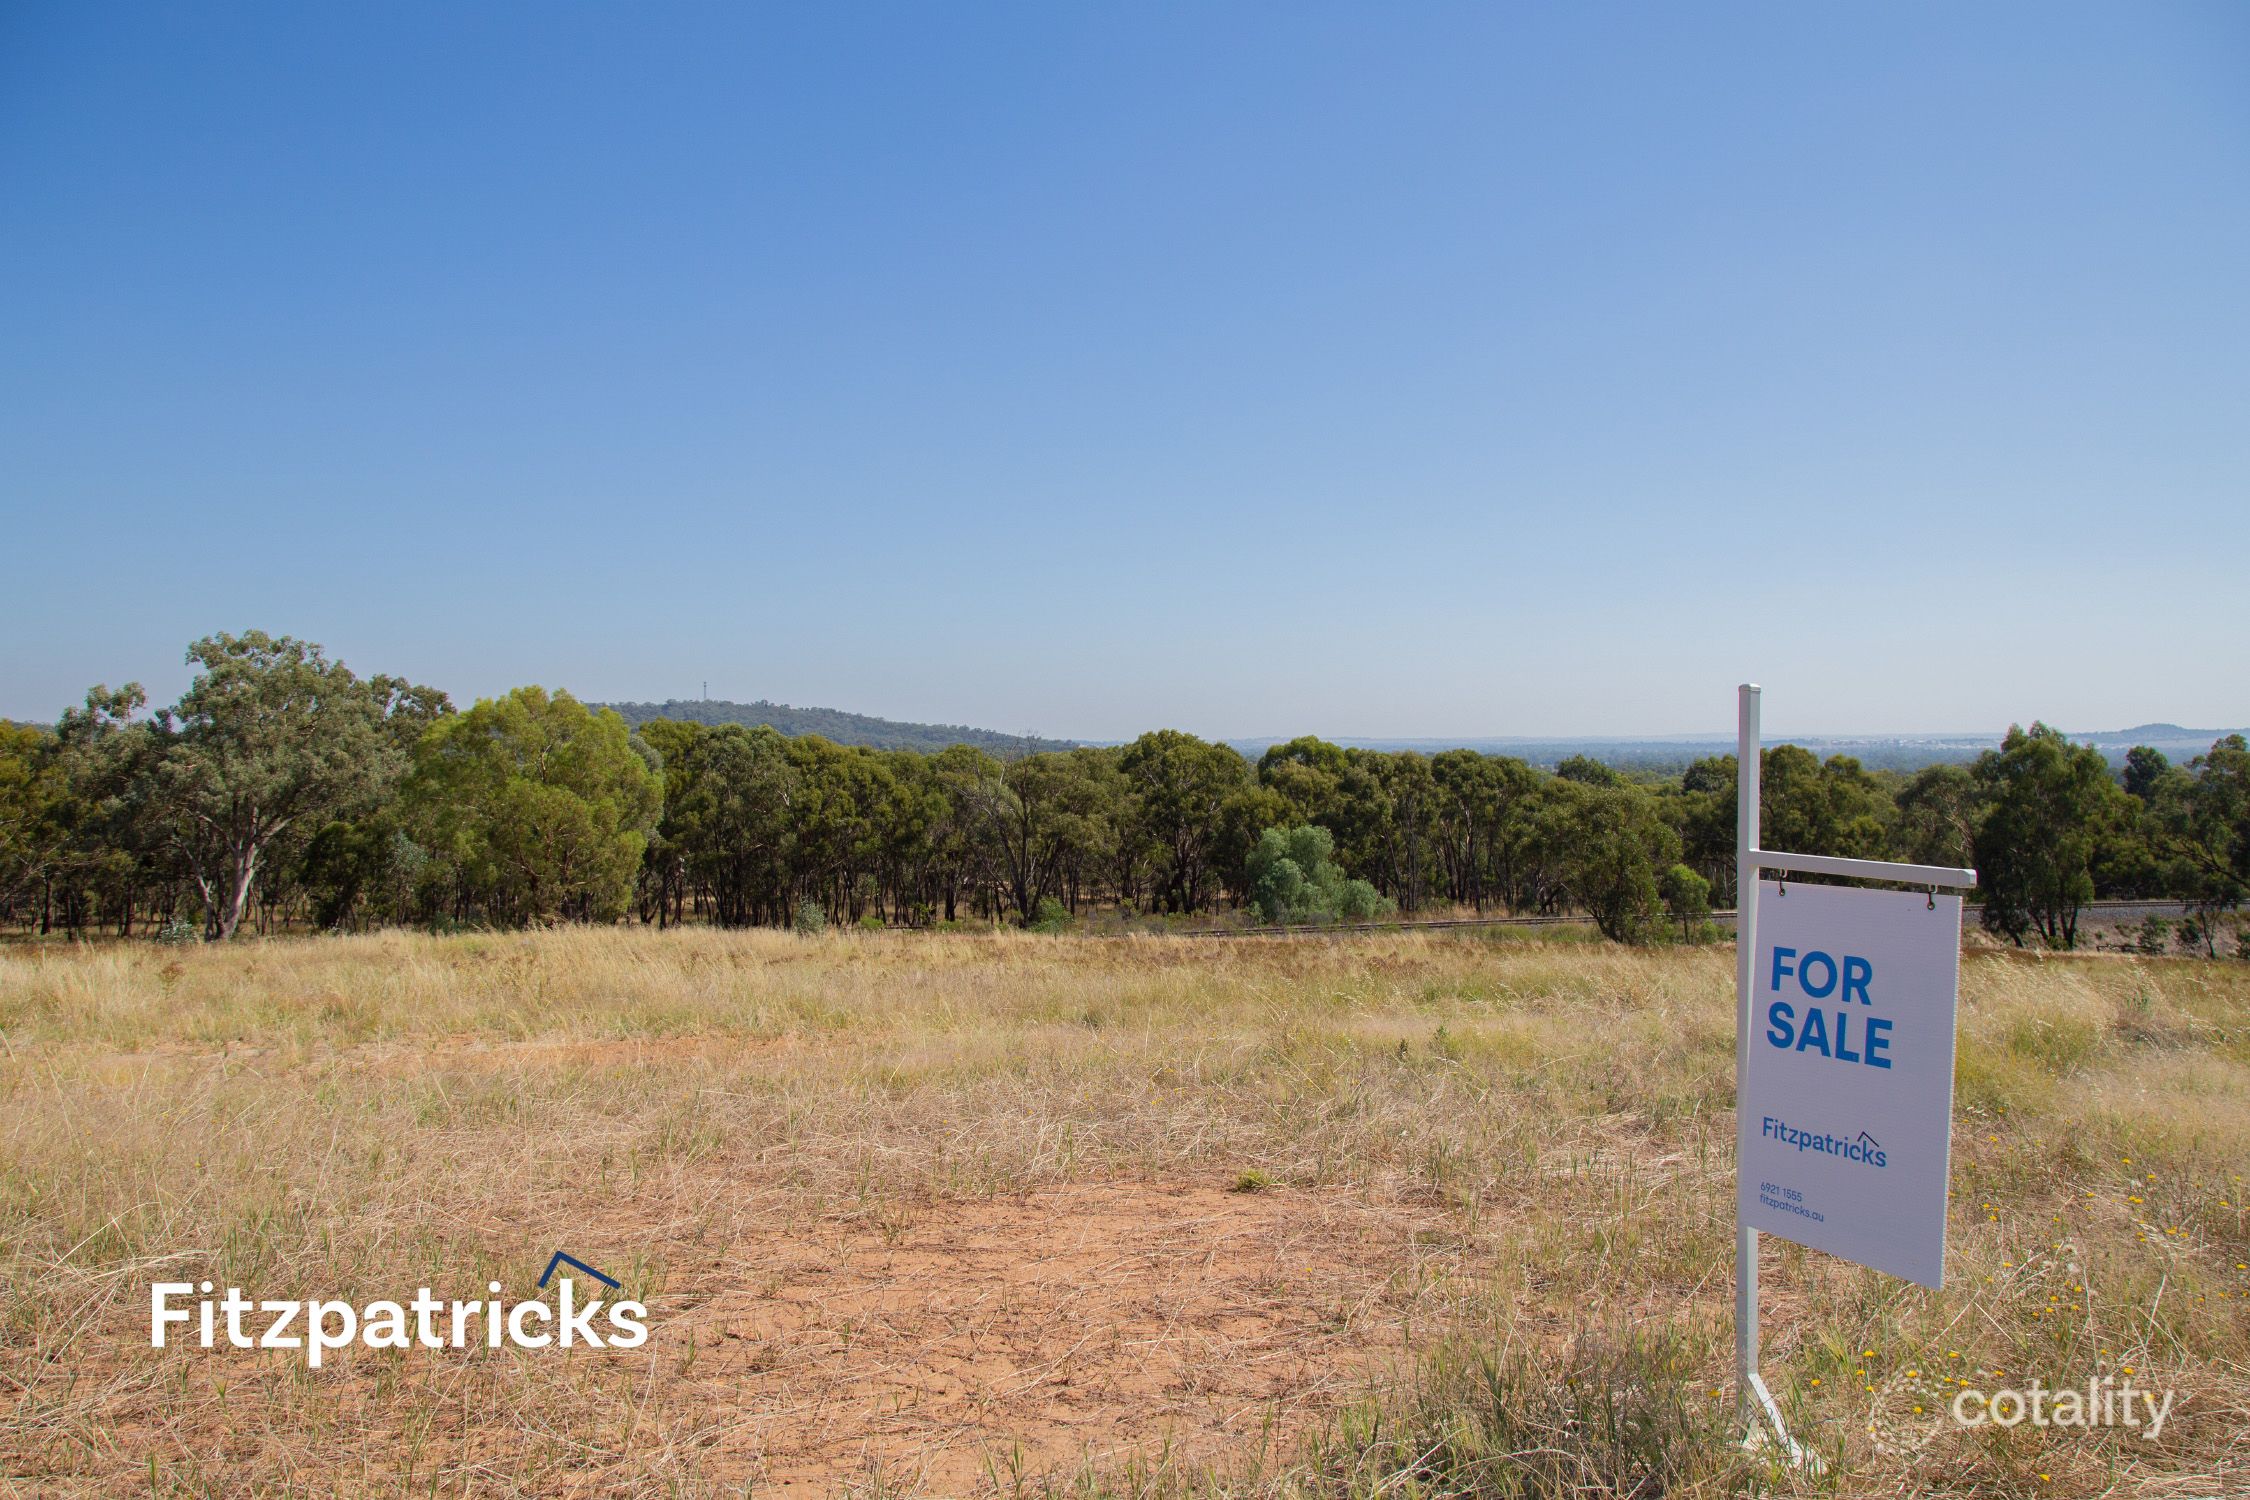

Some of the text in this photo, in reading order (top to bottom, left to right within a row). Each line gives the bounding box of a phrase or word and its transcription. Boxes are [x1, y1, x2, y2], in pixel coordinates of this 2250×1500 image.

[1771, 946, 1873, 1006] FOR
[1766, 1001, 1893, 1070] SALE
[1762, 1116, 1888, 1168] Fitzpatricks
[1760, 1181, 1803, 1202] 6921 1555
[1760, 1193, 1824, 1222] fitzpatricks.au
